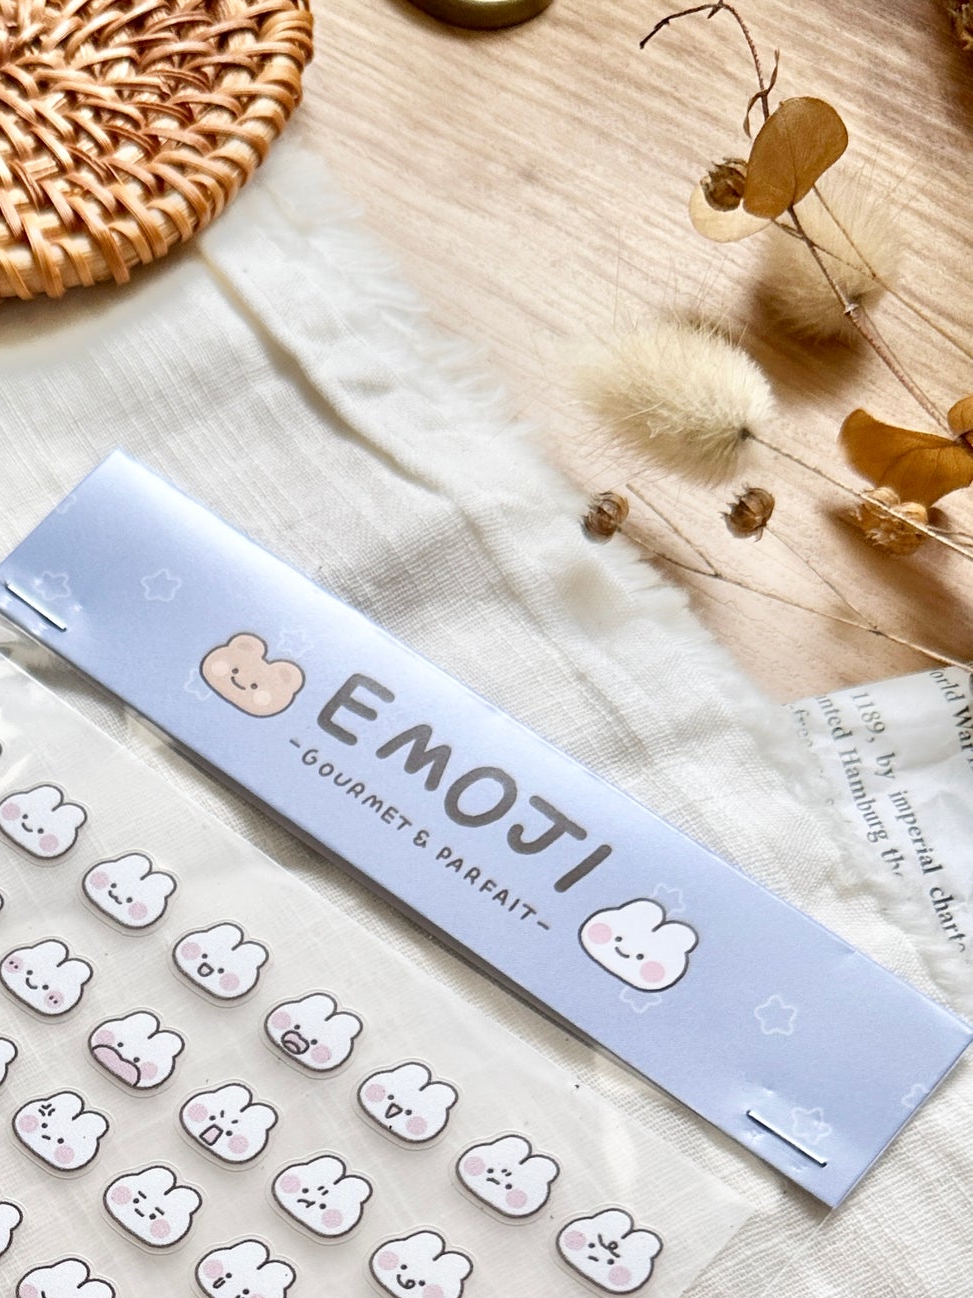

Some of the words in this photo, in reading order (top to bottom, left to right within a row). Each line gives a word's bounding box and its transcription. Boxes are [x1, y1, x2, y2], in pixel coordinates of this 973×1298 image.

[928, 669, 966, 702] orld
[316, 672, 613, 894] EMOJI
[413, 829, 429, 849] &
[815, 695, 854, 742] nted
[838, 747, 889, 843] Hamburg
[880, 848, 905, 877] th
[850, 692, 886, 743] 1189,
[874, 751, 896, 780] by
[888, 790, 944, 876] imperial
